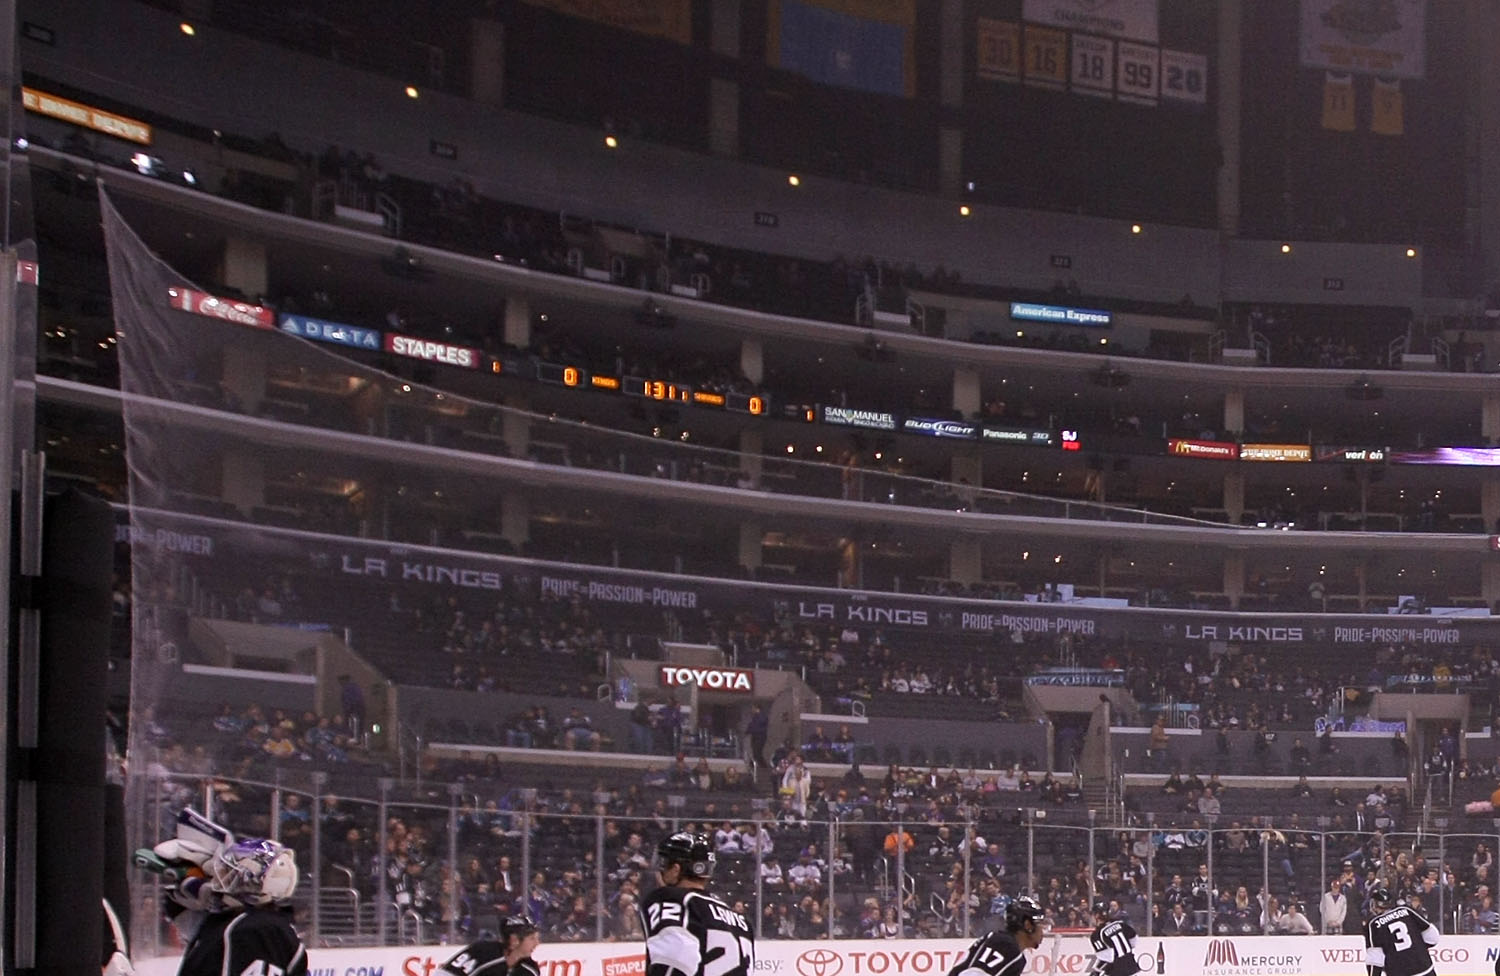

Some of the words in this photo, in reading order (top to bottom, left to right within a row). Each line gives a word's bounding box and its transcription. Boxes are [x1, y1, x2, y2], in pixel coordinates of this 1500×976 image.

[1079, 53, 1104, 81] 18
[1124, 61, 1152, 88] 99
[1166, 66, 1201, 93] 20
[1012, 304, 1065, 319] American
[1066, 309, 1110, 323] Express
[305, 320, 377, 346] DELTA
[392, 335, 473, 367] STAPLES
[563, 366, 578, 387] 0
[825, 406, 846, 419] SAN
[854, 410, 895, 423] MANUEL
[937, 423, 974, 435] LIGHT
[983, 429, 1027, 441] Panasonic
[1062, 430, 1077, 441] SJ
[342, 555, 388, 577] LA
[402, 560, 501, 590] KINGS
[799, 602, 835, 620] LA
[847, 605, 929, 626] KINGS
[1185, 625, 1217, 640] LA
[1228, 626, 1303, 642] KINGS
[662, 667, 750, 689] TOYOTA
[647, 902, 682, 931] 22
[708, 903, 749, 932] LEWIS
[1374, 908, 1410, 929] JOHNSON
[1111, 931, 1132, 958] 11
[1388, 921, 1413, 952] 3
[451, 953, 478, 975] 94
[605, 955, 646, 976] STAPLE
[980, 947, 1004, 969] 17
[1240, 955, 1303, 968] MERCURY
[1321, 949, 1366, 963] WEL
[1429, 949, 1470, 963] RGO
